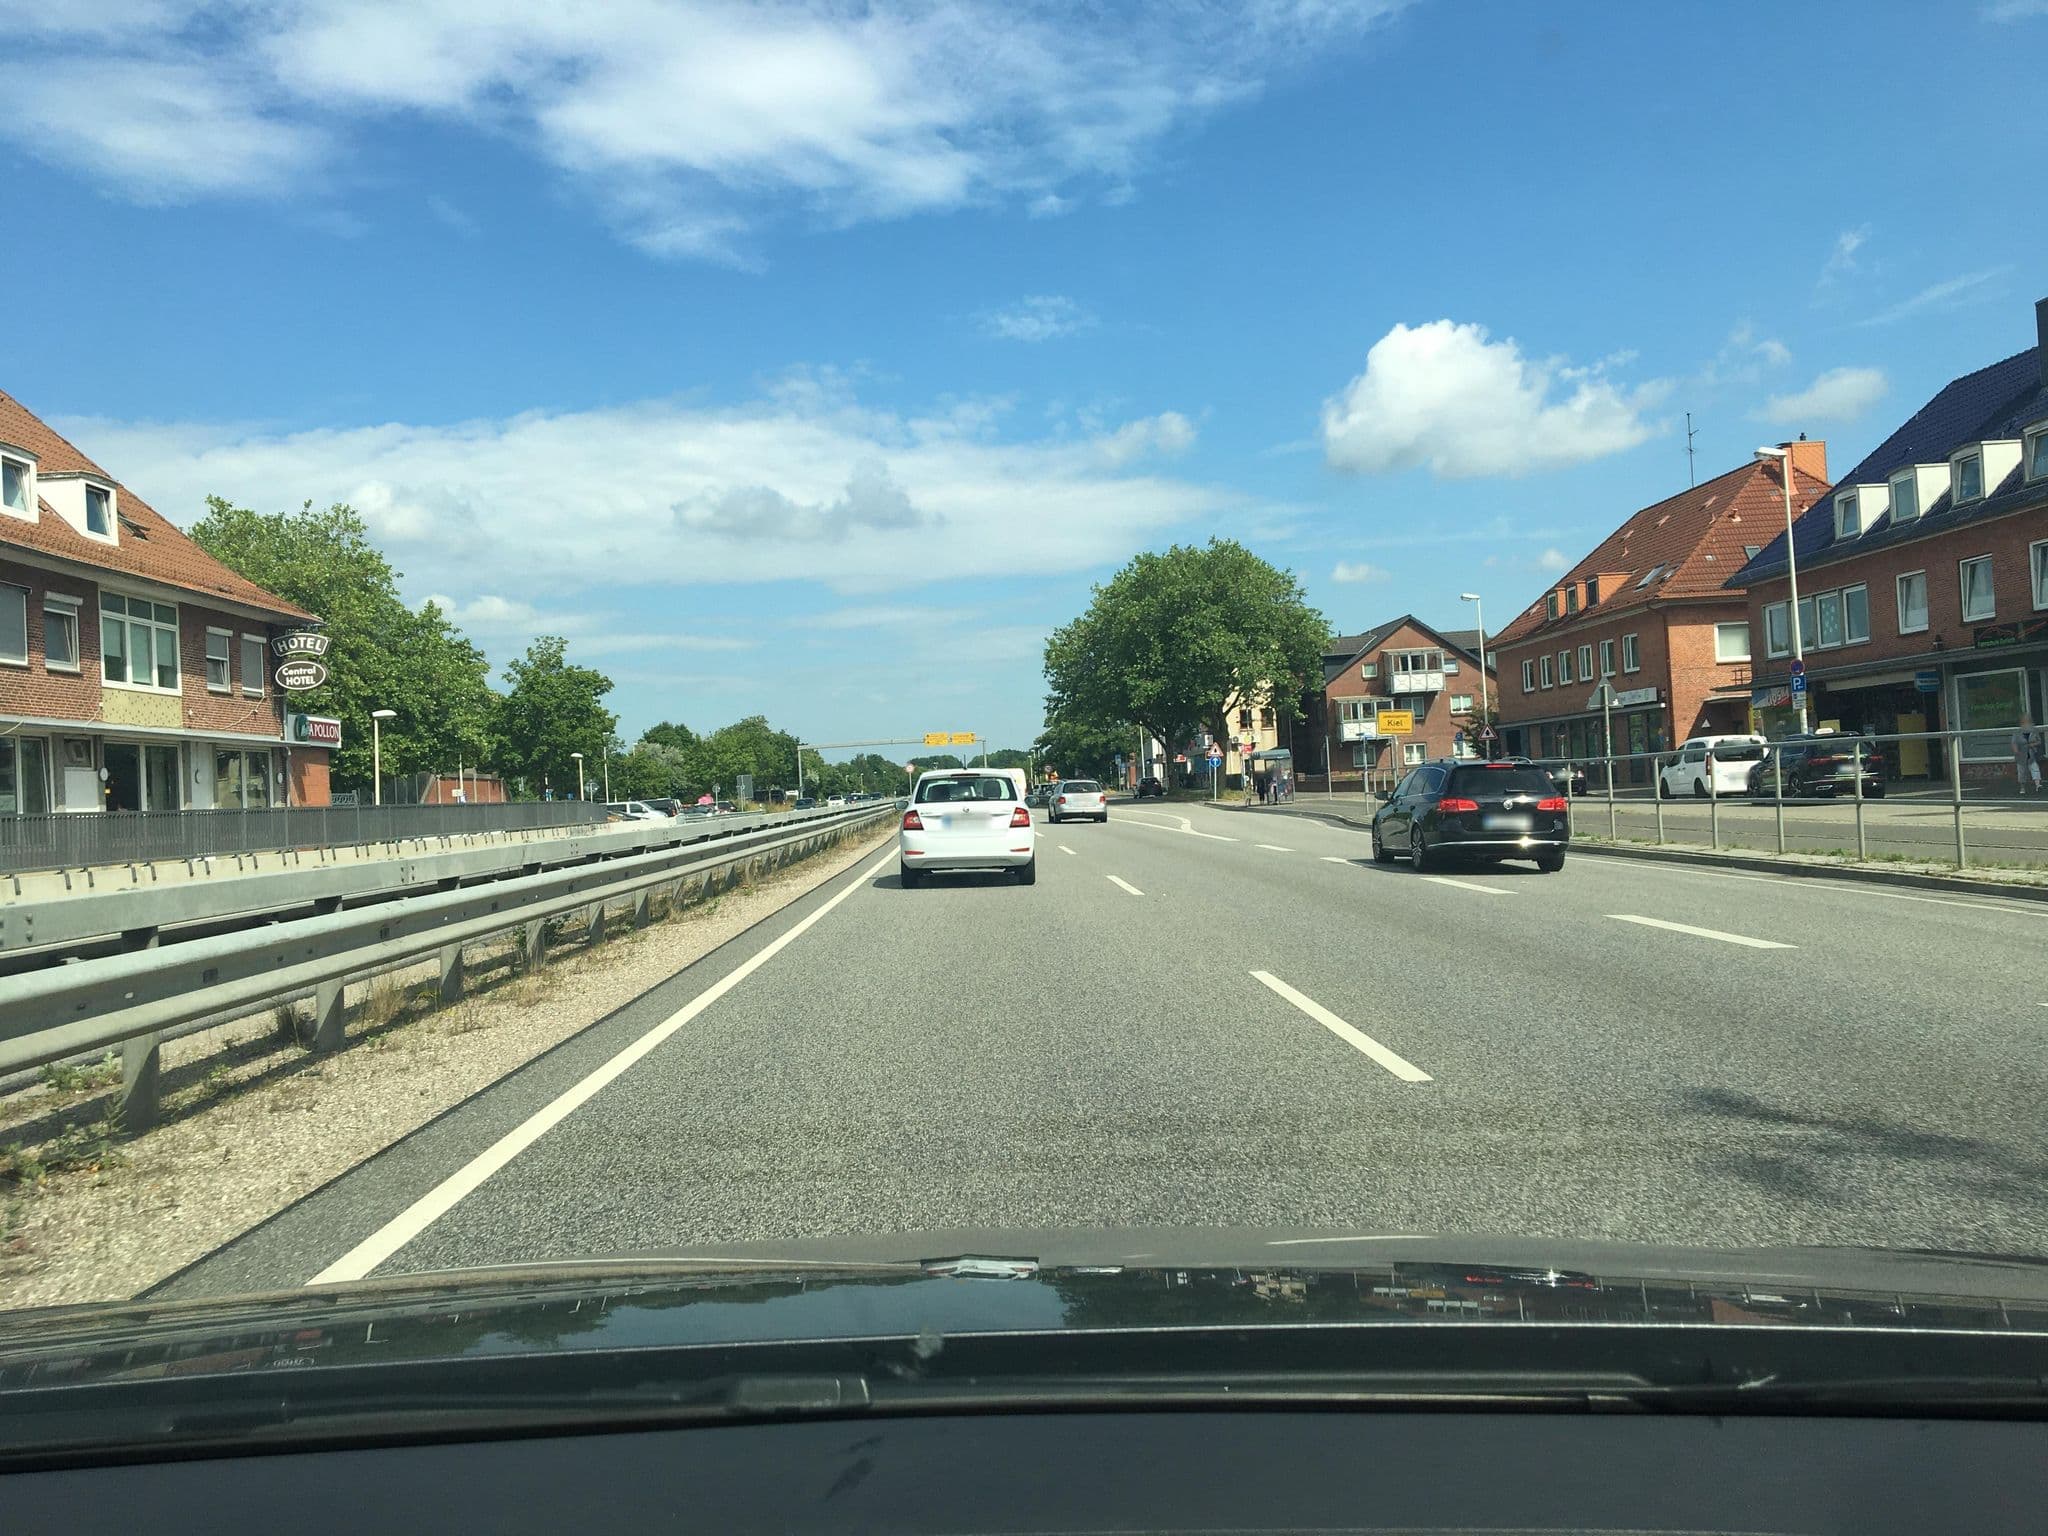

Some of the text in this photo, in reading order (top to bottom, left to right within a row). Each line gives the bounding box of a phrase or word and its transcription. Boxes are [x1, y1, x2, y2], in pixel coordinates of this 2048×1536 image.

[277, 637, 323, 652] HOTEL
[282, 666, 316, 676] Central
[286, 676, 316, 686] HOTEL
[1793, 678, 1801, 690] P
[309, 723, 339, 739] APOLLON
